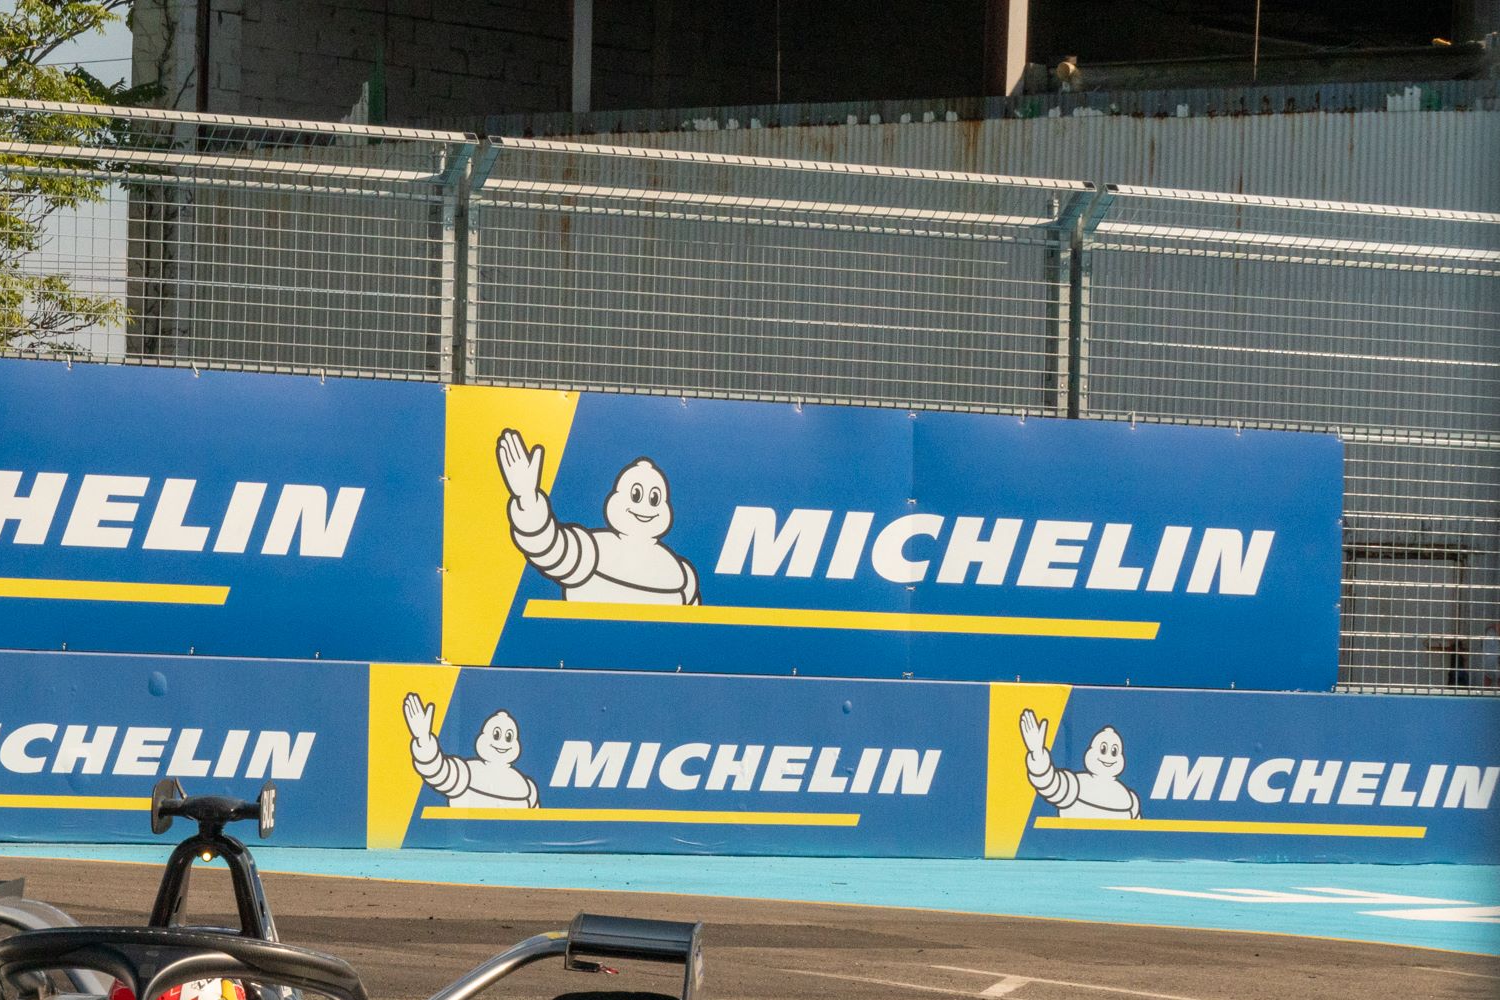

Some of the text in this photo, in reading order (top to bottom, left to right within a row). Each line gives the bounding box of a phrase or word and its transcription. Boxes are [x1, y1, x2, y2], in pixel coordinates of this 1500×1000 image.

[715, 506, 1275, 595] MICHELIN
[550, 741, 941, 794] MICHELIN
[1150, 755, 1500, 809] MICHELIN
